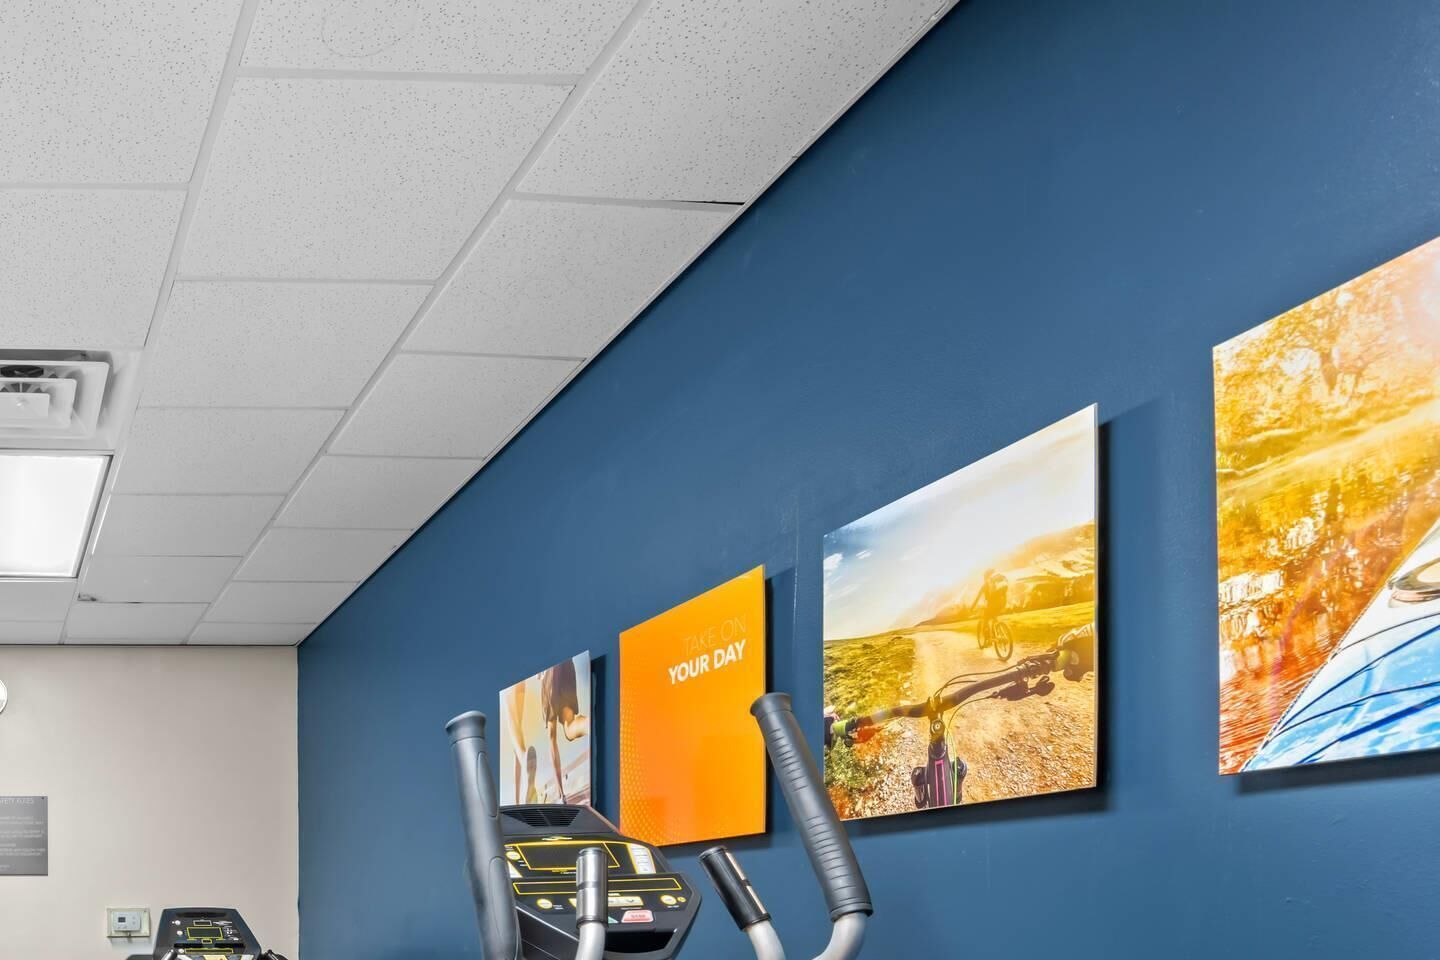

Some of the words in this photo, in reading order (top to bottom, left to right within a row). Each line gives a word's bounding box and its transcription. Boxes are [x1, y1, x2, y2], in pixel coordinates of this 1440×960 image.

[684, 626, 717, 656] TAKE
[721, 616, 747, 641] ON
[668, 653, 710, 685] YOUR
[713, 638, 747, 670] DAY
